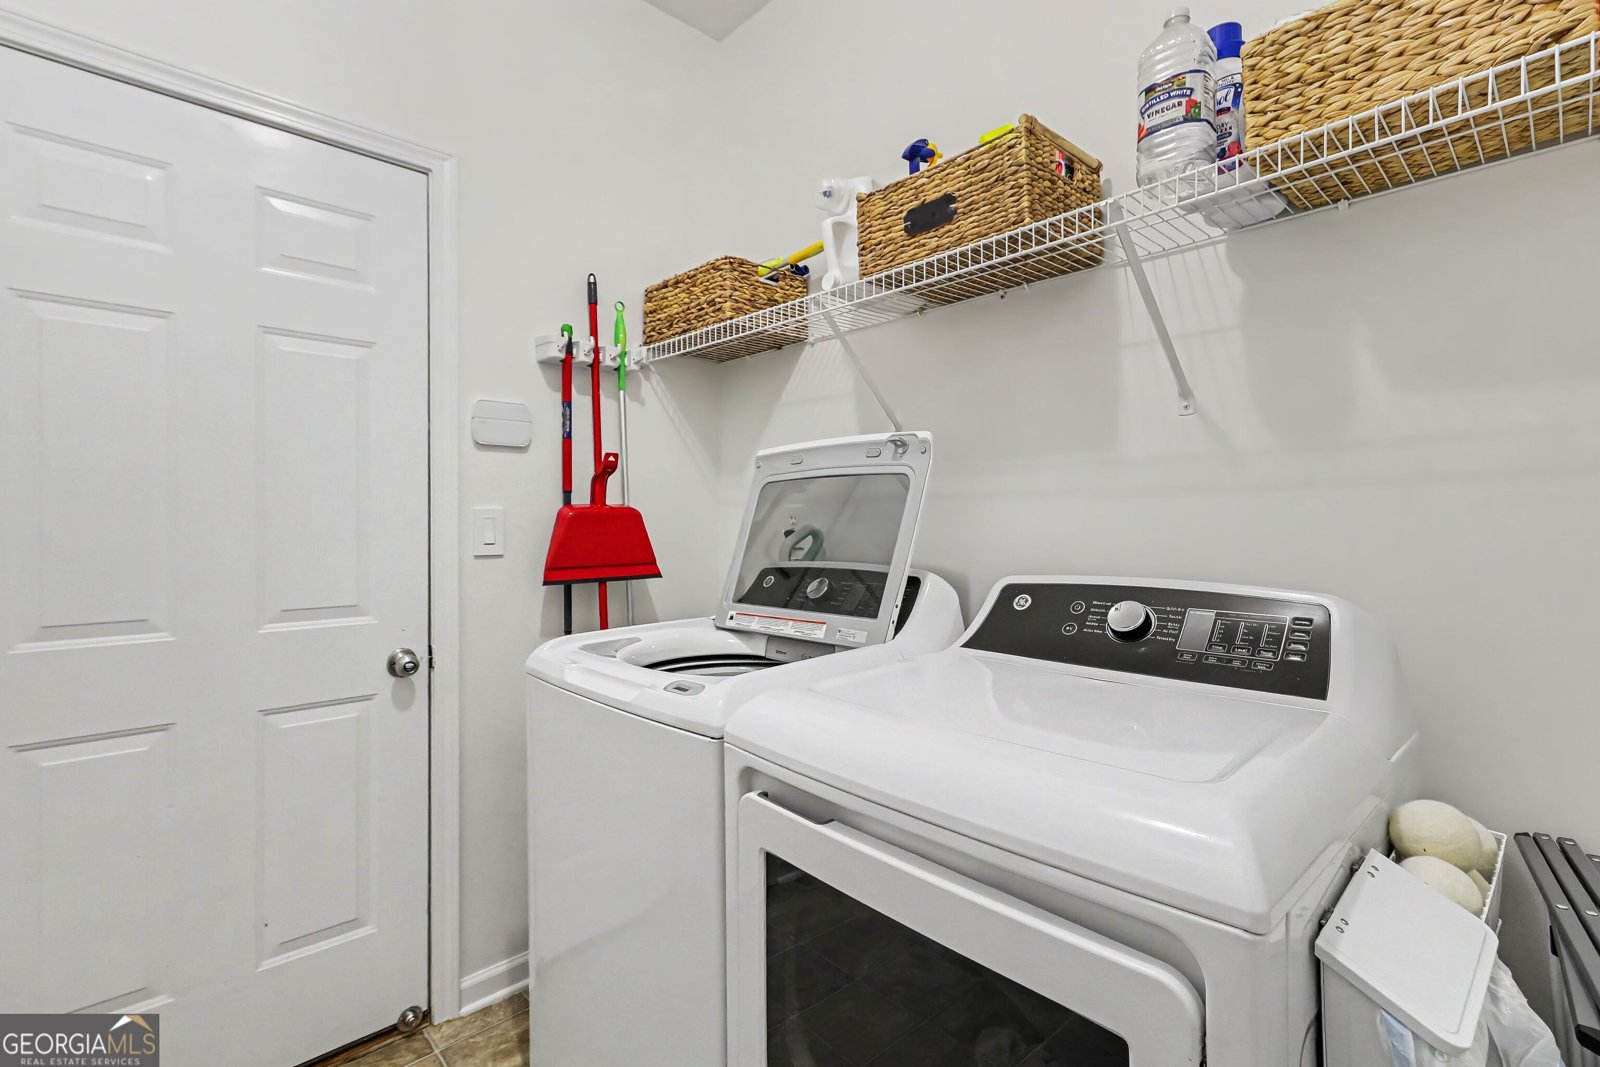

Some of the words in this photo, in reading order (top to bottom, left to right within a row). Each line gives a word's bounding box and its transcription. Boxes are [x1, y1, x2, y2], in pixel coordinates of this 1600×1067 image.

[1141, 93, 1169, 113] DISTILLED
[1170, 89, 1191, 97] WHITE
[1146, 101, 1183, 119] VINEGAR
